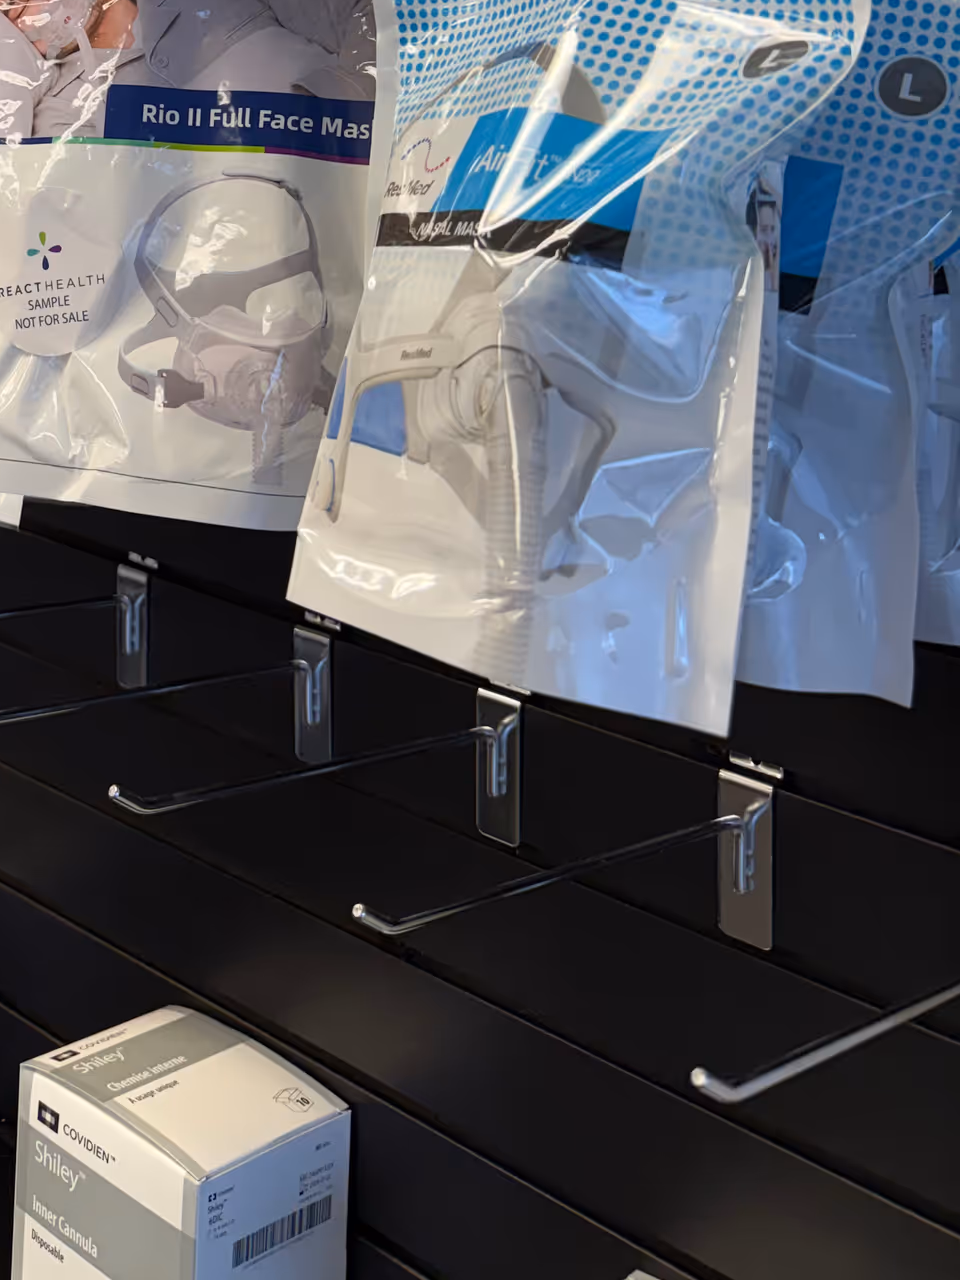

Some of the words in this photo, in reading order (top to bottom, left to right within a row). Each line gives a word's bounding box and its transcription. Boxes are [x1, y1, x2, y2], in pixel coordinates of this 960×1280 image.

[898, 72, 923, 104] L
[141, 103, 181, 127] Rio
[187, 107, 202, 127] II
[208, 107, 252, 129] Full
[258, 108, 314, 134] Face
[320, 116, 373, 141] Mas
[416, 220, 452, 238] NASAL
[453, 220, 491, 239] MASK
[27, 294, 71, 312] SAMPLE
[15, 316, 37, 331] NOT
[39, 312, 60, 328] FOR
[61, 310, 90, 324] SALE
[106, 1069, 151, 1093] Chemise
[149, 1053, 189, 1076] interne
[155, 1077, 181, 1096] unique
[295, 1095, 311, 1108] 10
[32, 1193, 58, 1228] Inner
[57, 1216, 99, 1259] Cannula
[30, 1228, 66, 1264] Disposable
